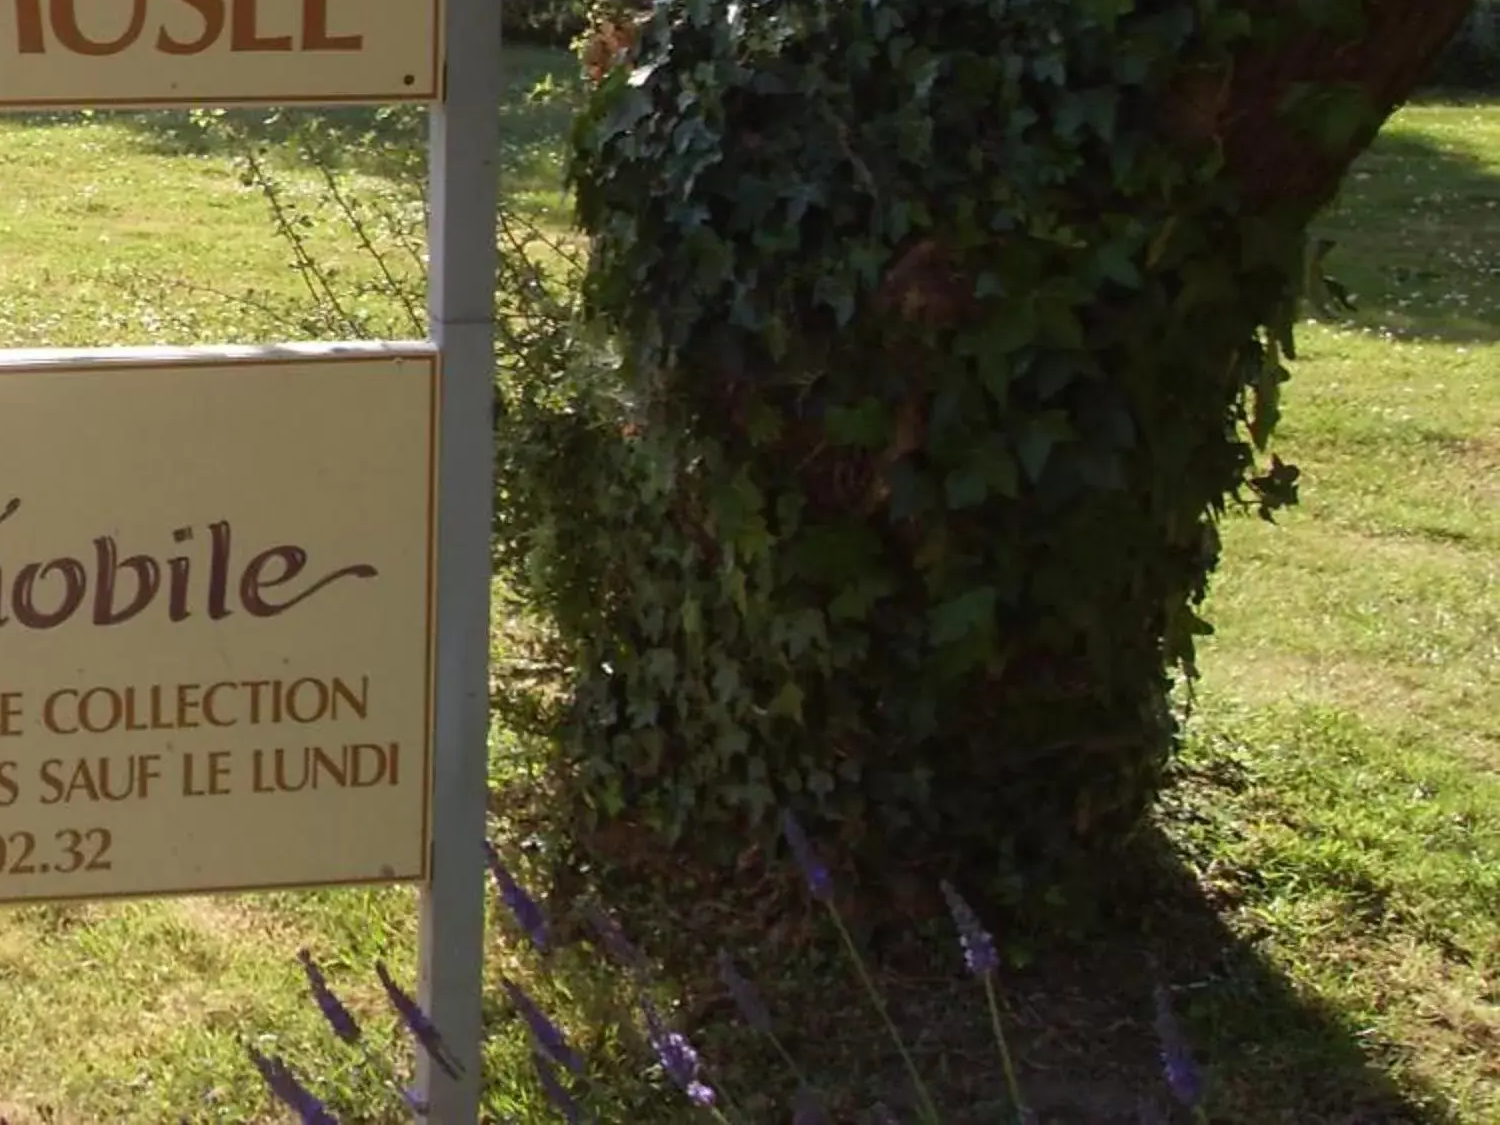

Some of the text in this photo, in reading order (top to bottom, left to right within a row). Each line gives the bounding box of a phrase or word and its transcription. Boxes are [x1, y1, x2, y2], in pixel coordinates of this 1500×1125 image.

[44, 675, 369, 735] COLLECTION
[40, 754, 161, 805] SAUF
[183, 751, 232, 797] LE
[253, 742, 400, 793] LUNDI
